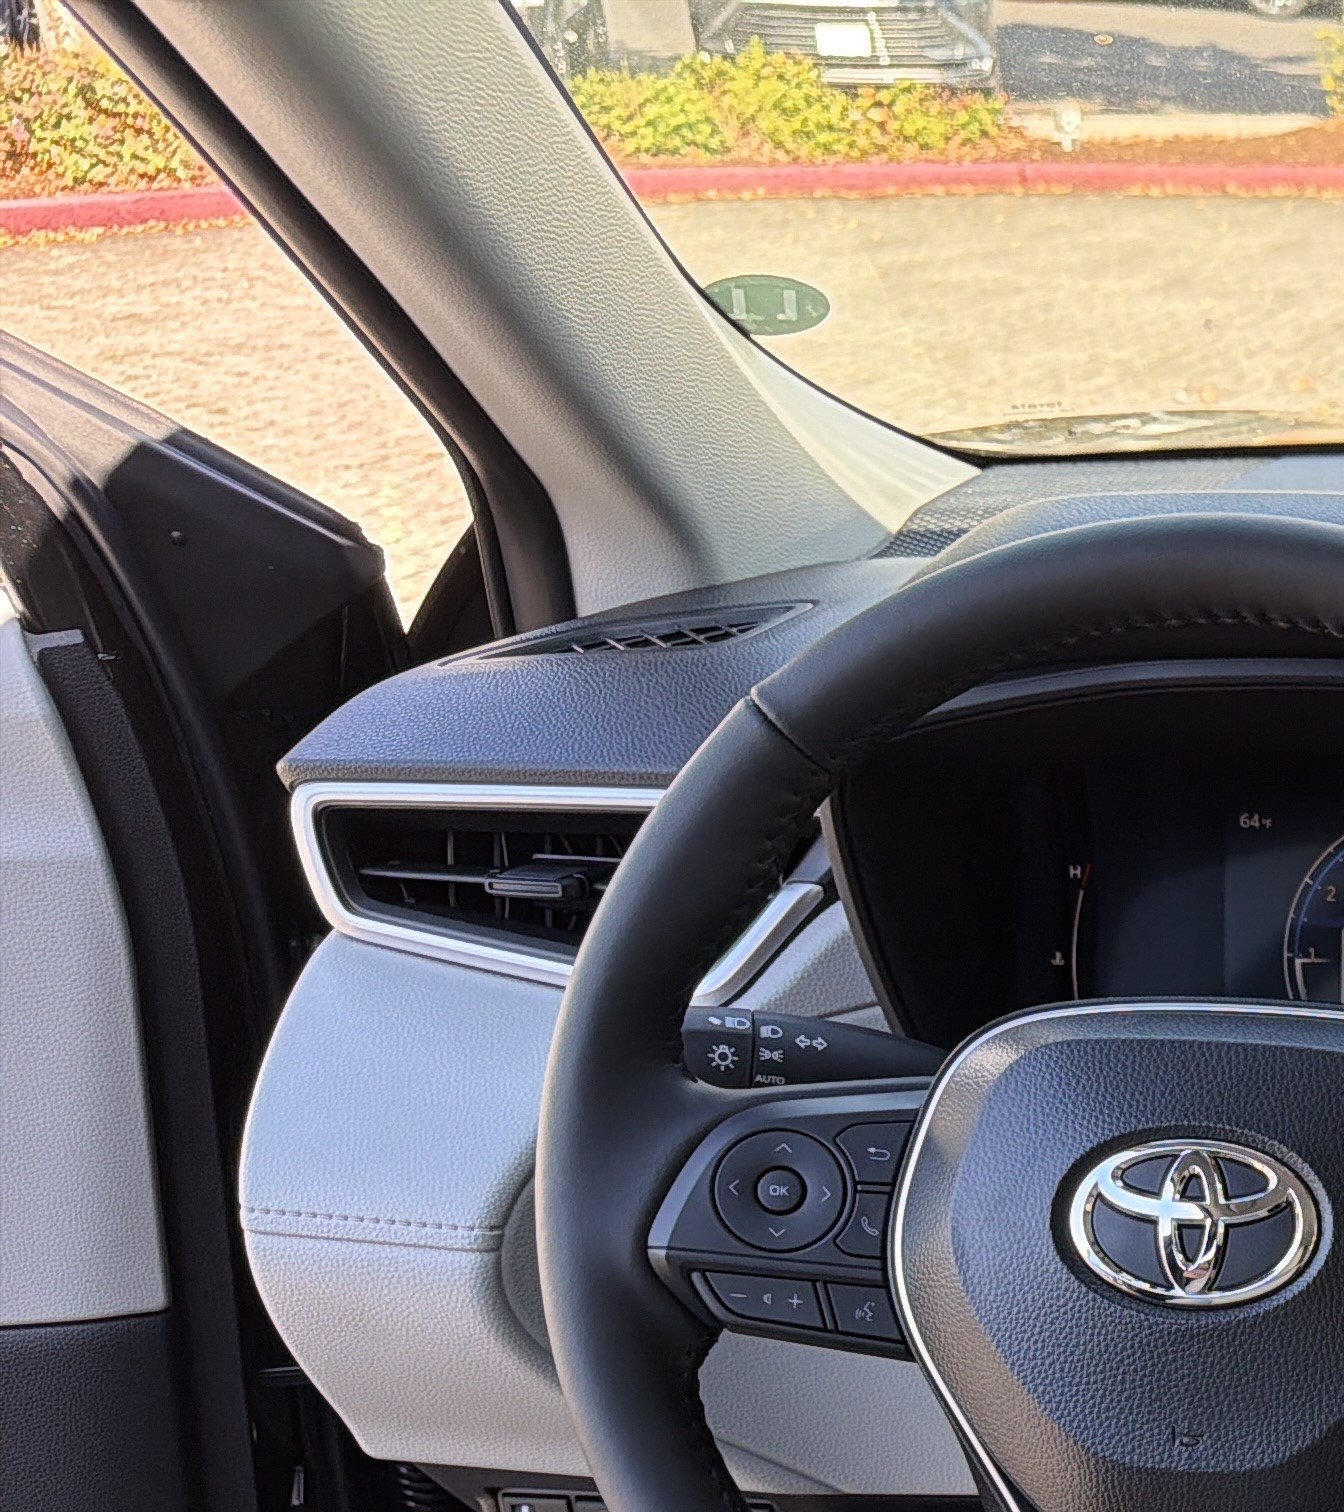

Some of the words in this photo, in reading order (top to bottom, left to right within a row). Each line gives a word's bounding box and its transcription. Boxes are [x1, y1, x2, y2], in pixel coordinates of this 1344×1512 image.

[1070, 865, 1081, 879] H
[1326, 886, 1337, 902] 2
[754, 1074, 786, 1085] AUTO
[769, 1185, 789, 1196] OK
